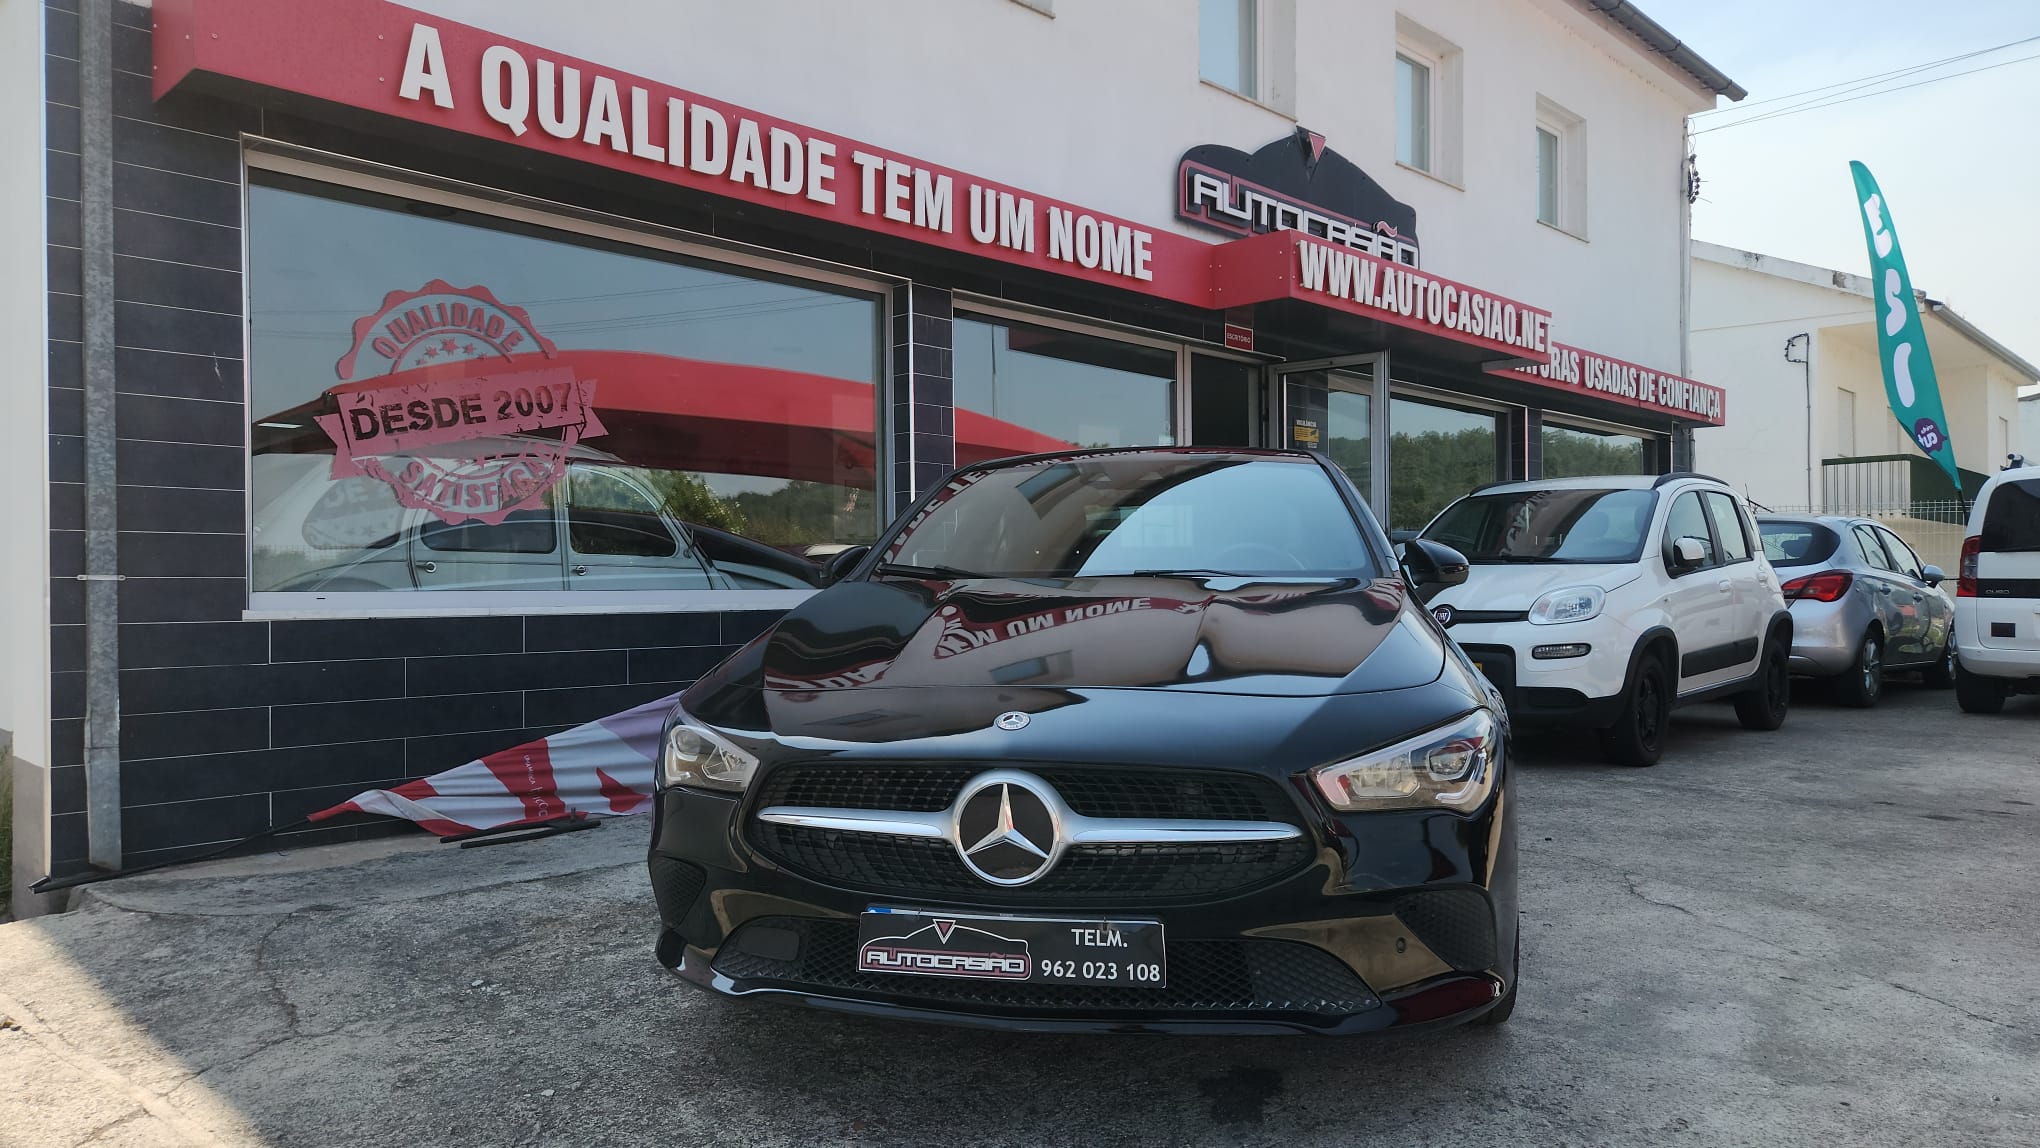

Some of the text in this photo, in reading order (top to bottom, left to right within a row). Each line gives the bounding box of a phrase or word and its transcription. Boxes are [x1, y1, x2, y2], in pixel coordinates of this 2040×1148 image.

[399, 22, 1153, 282] A QUALIDADE TEM UM NOME
[1299, 239, 1553, 354] WWW.AUTOCASIAO.NET
[372, 302, 525, 360] QUALIDADE
[349, 382, 572, 441] DESDE 2007
[1584, 355, 1637, 399] USADAS
[1639, 370, 1656, 403] DE
[1658, 375, 1721, 422] CONFIANÇA
[1071, 928, 1129, 949] TELM.
[1041, 960, 1161, 983] 962 023 108
